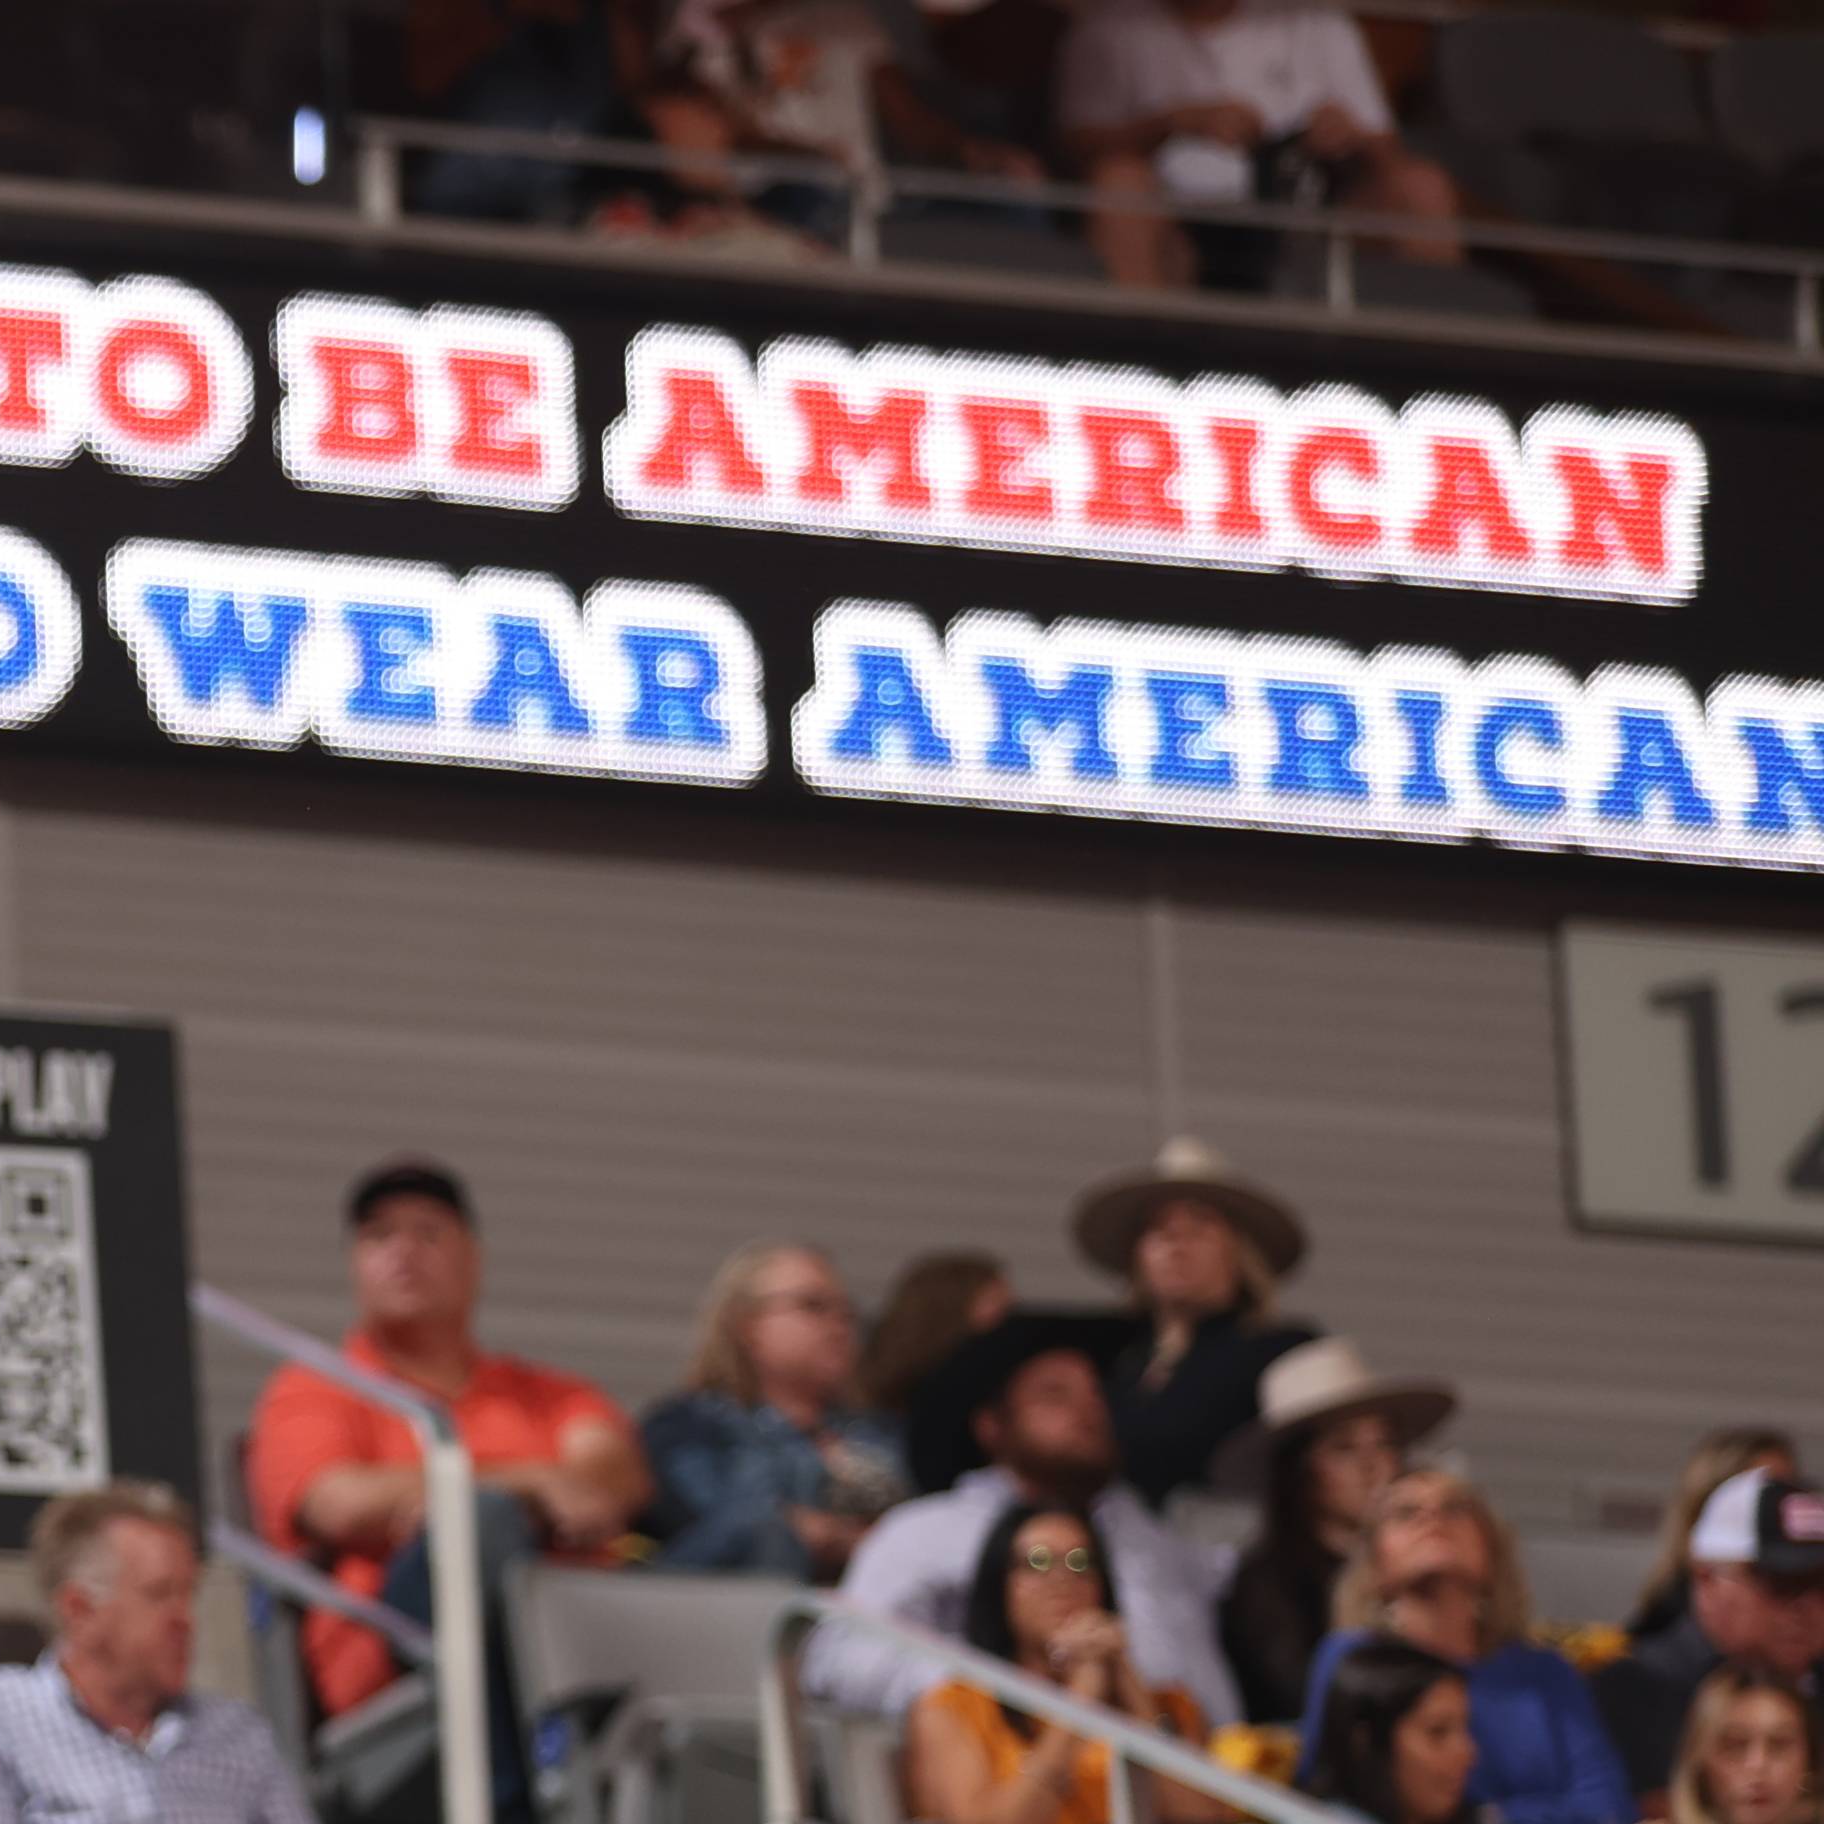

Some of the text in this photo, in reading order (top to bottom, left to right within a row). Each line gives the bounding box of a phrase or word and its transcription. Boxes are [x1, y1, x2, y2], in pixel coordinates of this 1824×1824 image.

[313, 337, 543, 476] BE
[642, 369, 1674, 575] AMERICAN
[142, 582, 728, 748] WEAR
